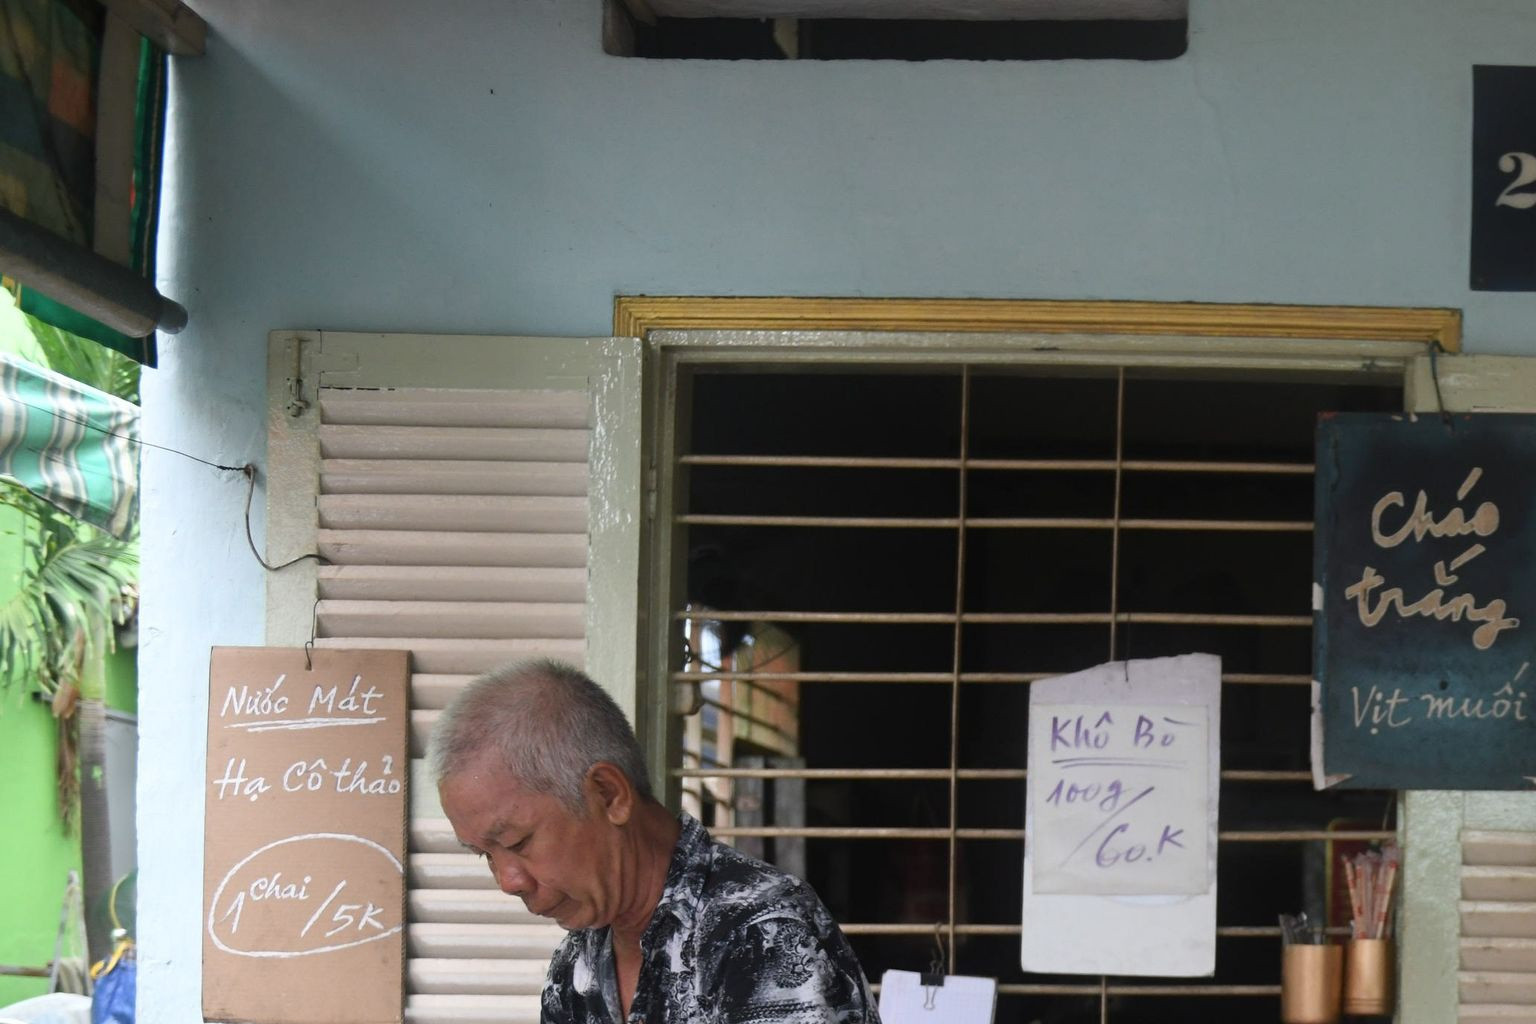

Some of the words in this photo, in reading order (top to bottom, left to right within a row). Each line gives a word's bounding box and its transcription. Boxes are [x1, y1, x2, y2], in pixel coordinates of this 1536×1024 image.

[1372, 467, 1500, 548] Cháo
[1345, 543, 1520, 650] trắng
[220, 674, 289, 718] Nước
[308, 675, 386, 716] Mát
[1352, 685, 1412, 734] Vịt
[1420, 662, 1530, 720] muối
[1050, 711, 1114, 752] Khô
[1133, 714, 1198, 749] Bò
[213, 757, 271, 802] Hạ
[283, 760, 327, 793] Cô
[330, 755, 401, 794] thảo
